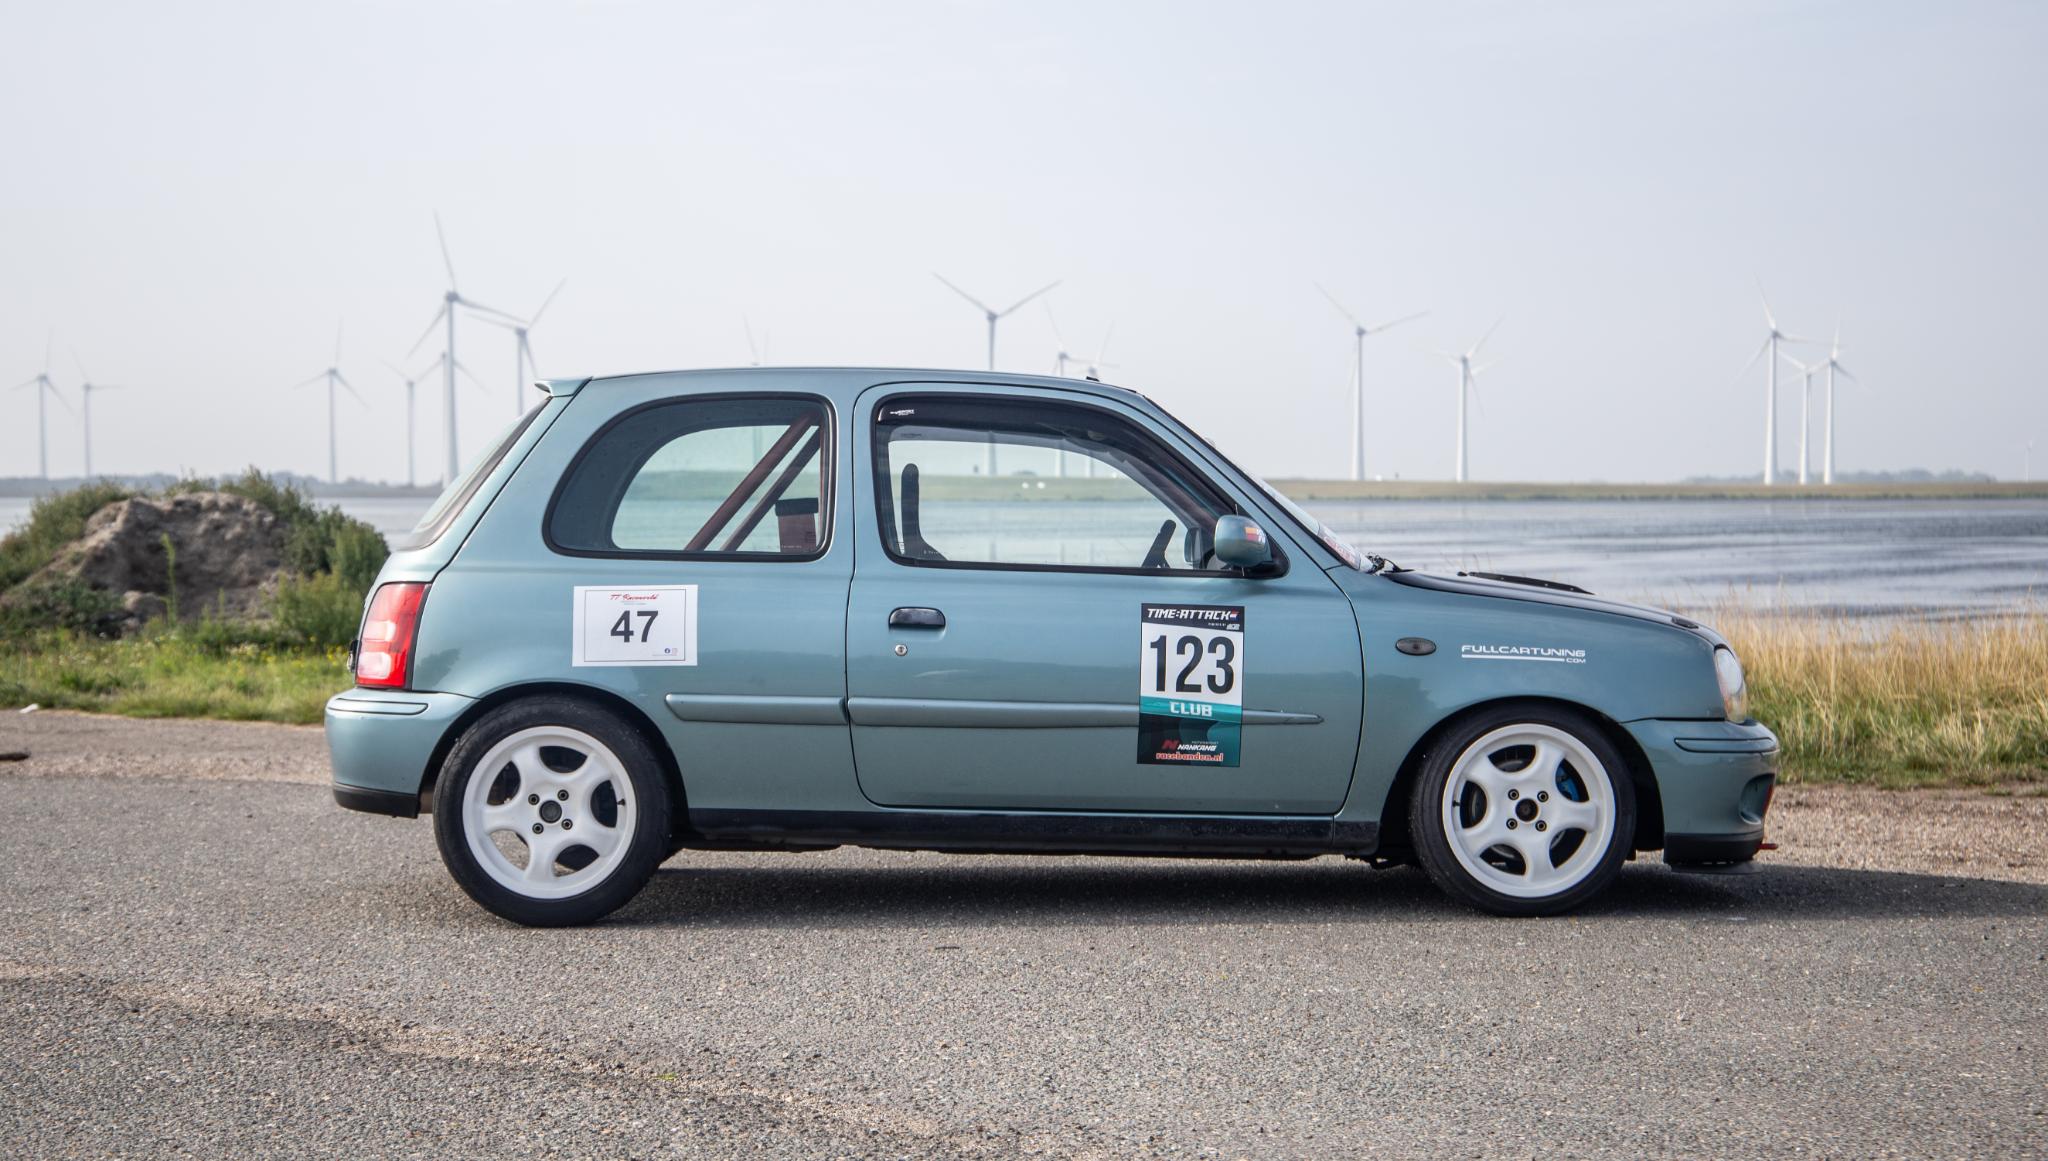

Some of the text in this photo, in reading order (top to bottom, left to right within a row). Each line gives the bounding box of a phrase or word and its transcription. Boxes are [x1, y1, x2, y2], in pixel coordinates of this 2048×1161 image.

[1147, 608, 1231, 620] TIME:ATTACK
[610, 610, 659, 643] 47
[1461, 645, 1586, 657] FULLCARTUNING
[1150, 635, 1235, 694] 123
[1169, 701, 1213, 717] CLUB
[1177, 744, 1217, 752] NANKANG
